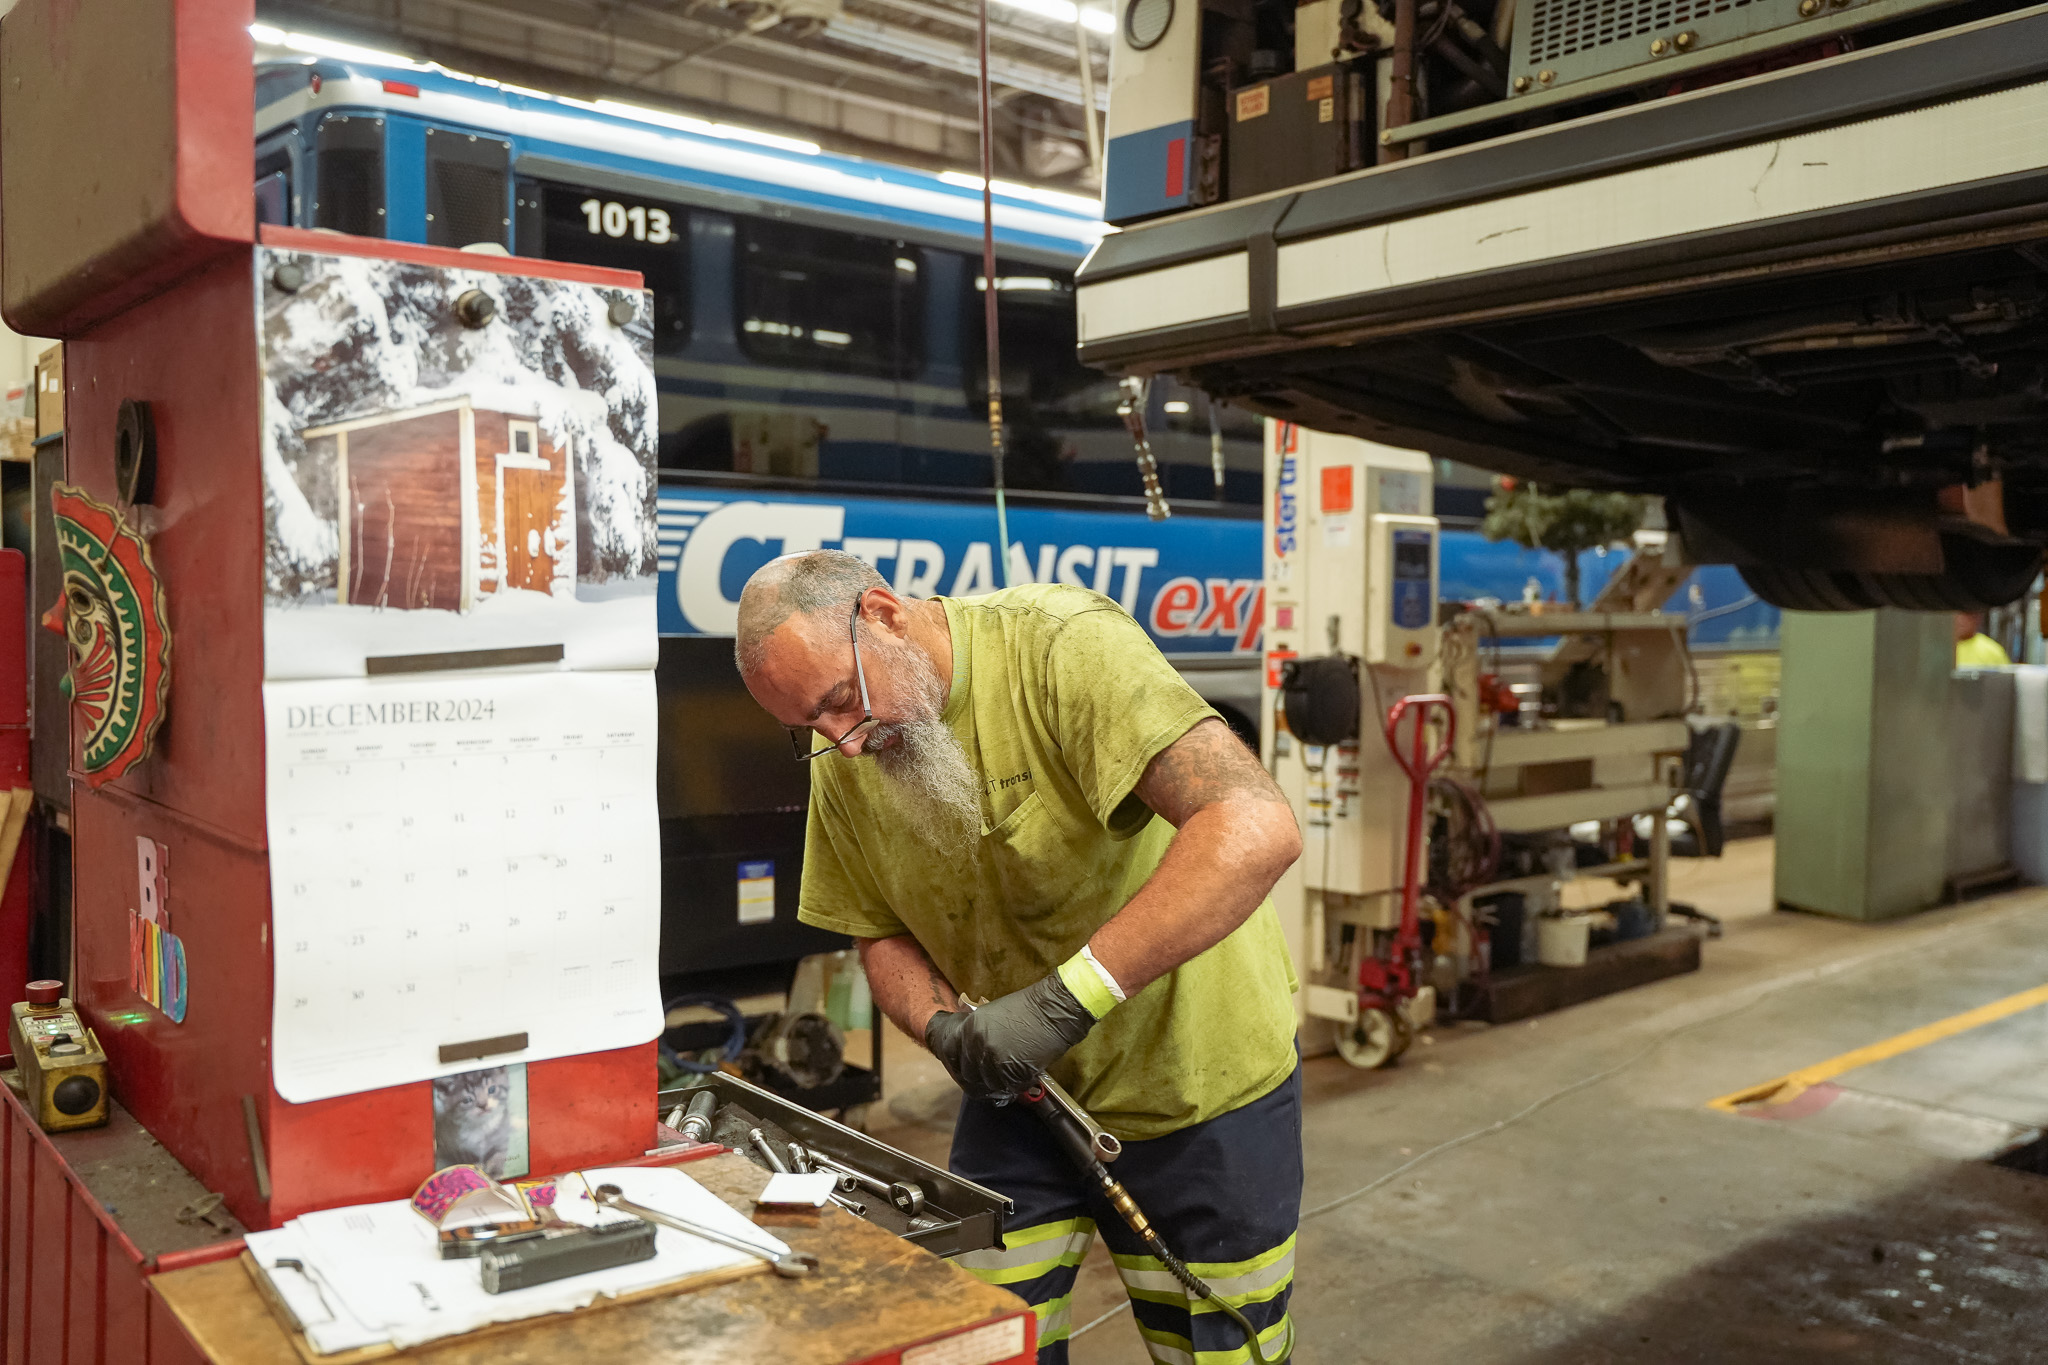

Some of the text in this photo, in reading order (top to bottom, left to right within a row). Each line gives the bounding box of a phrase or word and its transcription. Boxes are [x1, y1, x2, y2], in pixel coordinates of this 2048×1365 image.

[580, 199, 671, 244] 1013
[606, 731, 635, 739] SATURDAY
[136, 836, 169, 934] BE
[129, 908, 188, 1024] KIND
